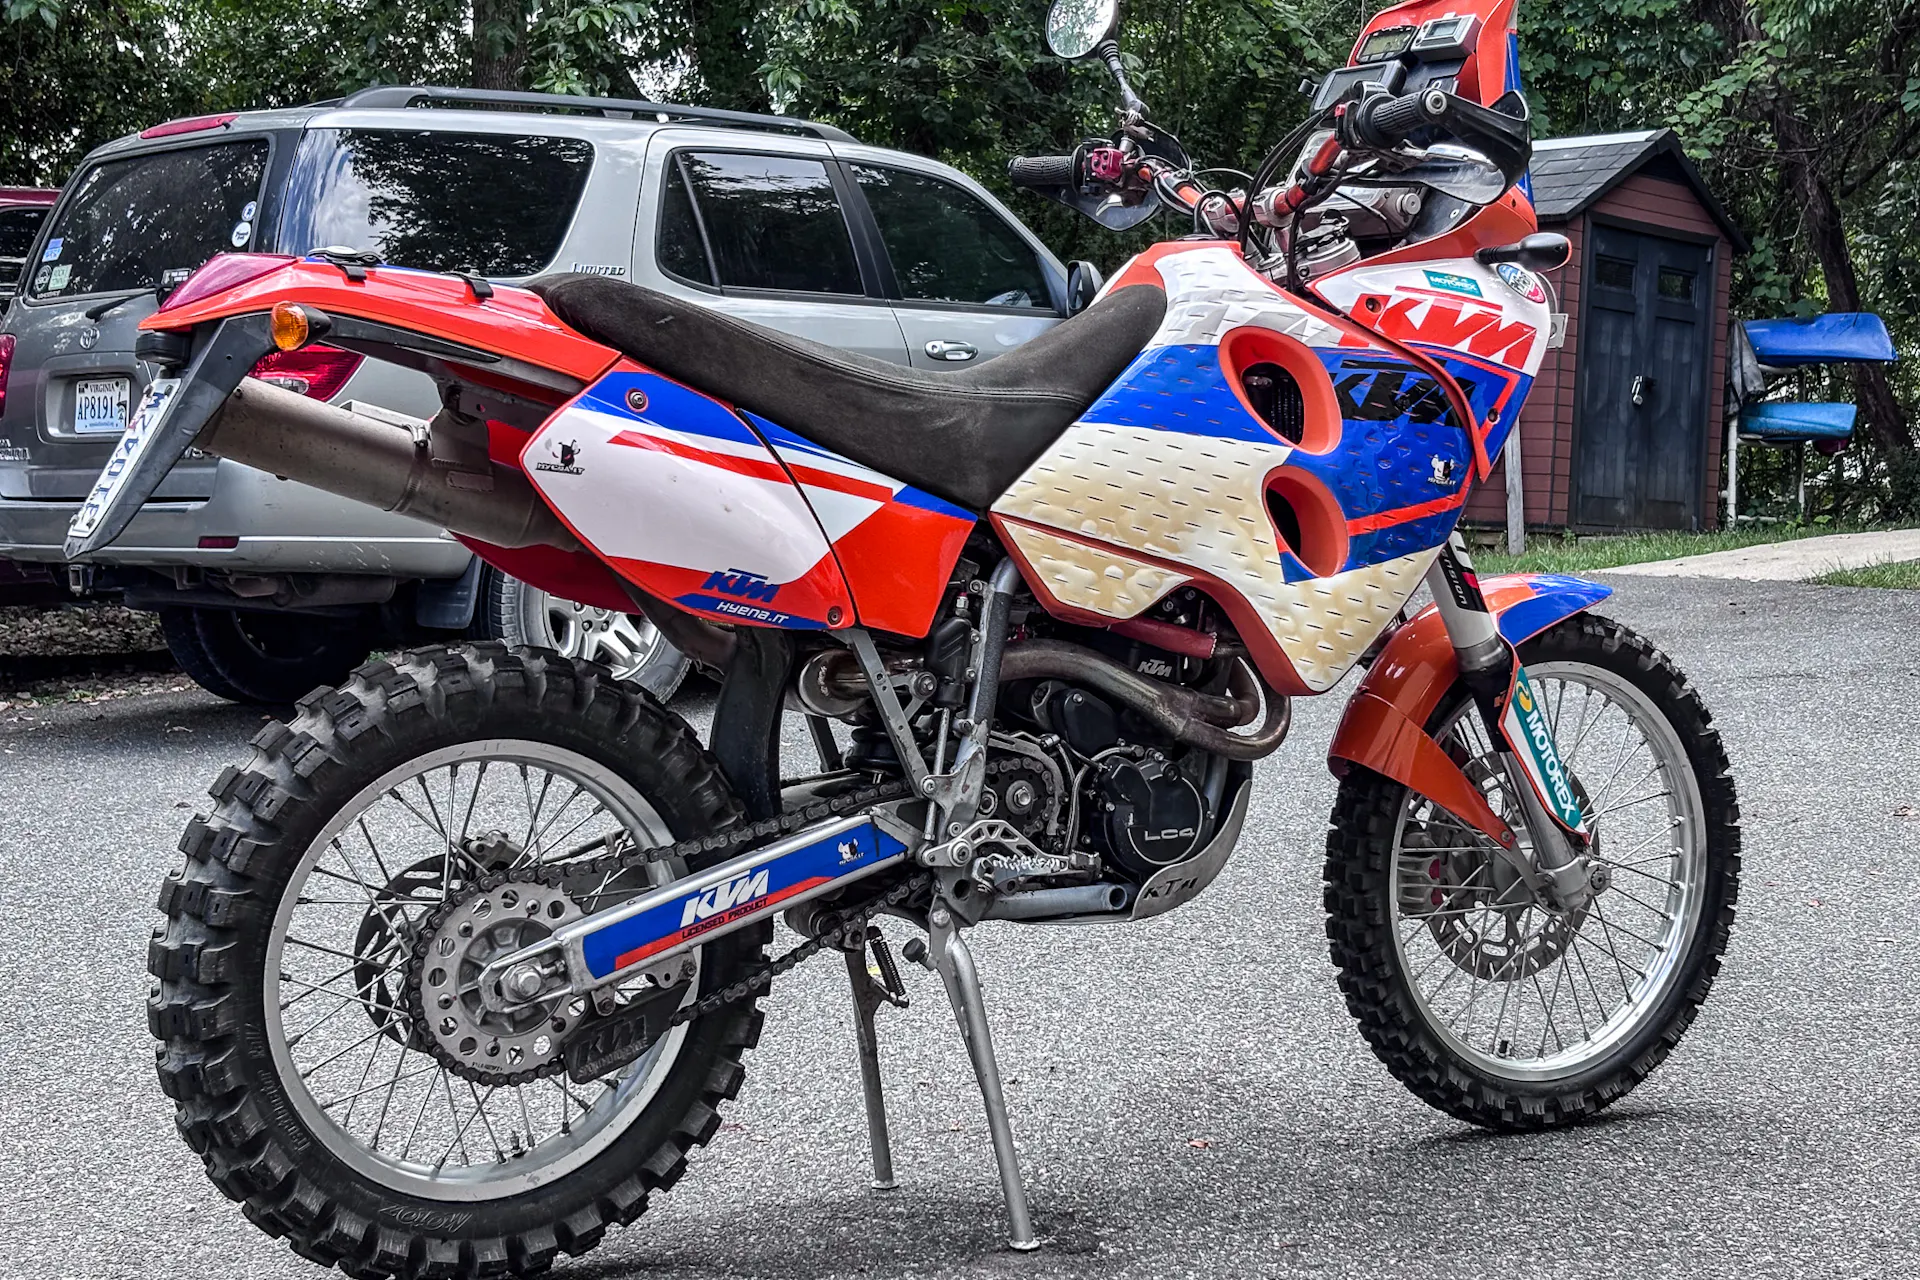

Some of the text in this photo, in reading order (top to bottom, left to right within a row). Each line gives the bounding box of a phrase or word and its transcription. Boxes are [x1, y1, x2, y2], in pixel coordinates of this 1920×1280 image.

[571, 262, 626, 276] LIMITED
[1339, 285, 1537, 370] KTM
[90, 383, 115, 393] VIRGINIA
[78, 396, 114, 420] AP8191
[701, 568, 781, 603] KTM
[1137, 658, 1173, 678] KTM
[1525, 711, 1578, 821] MOTOREX
[1144, 827, 1195, 842] LC4
[680, 868, 770, 929] KTM
[1143, 876, 1199, 900] KTM
[682, 897, 768, 939] LICENSED PRODUCT
